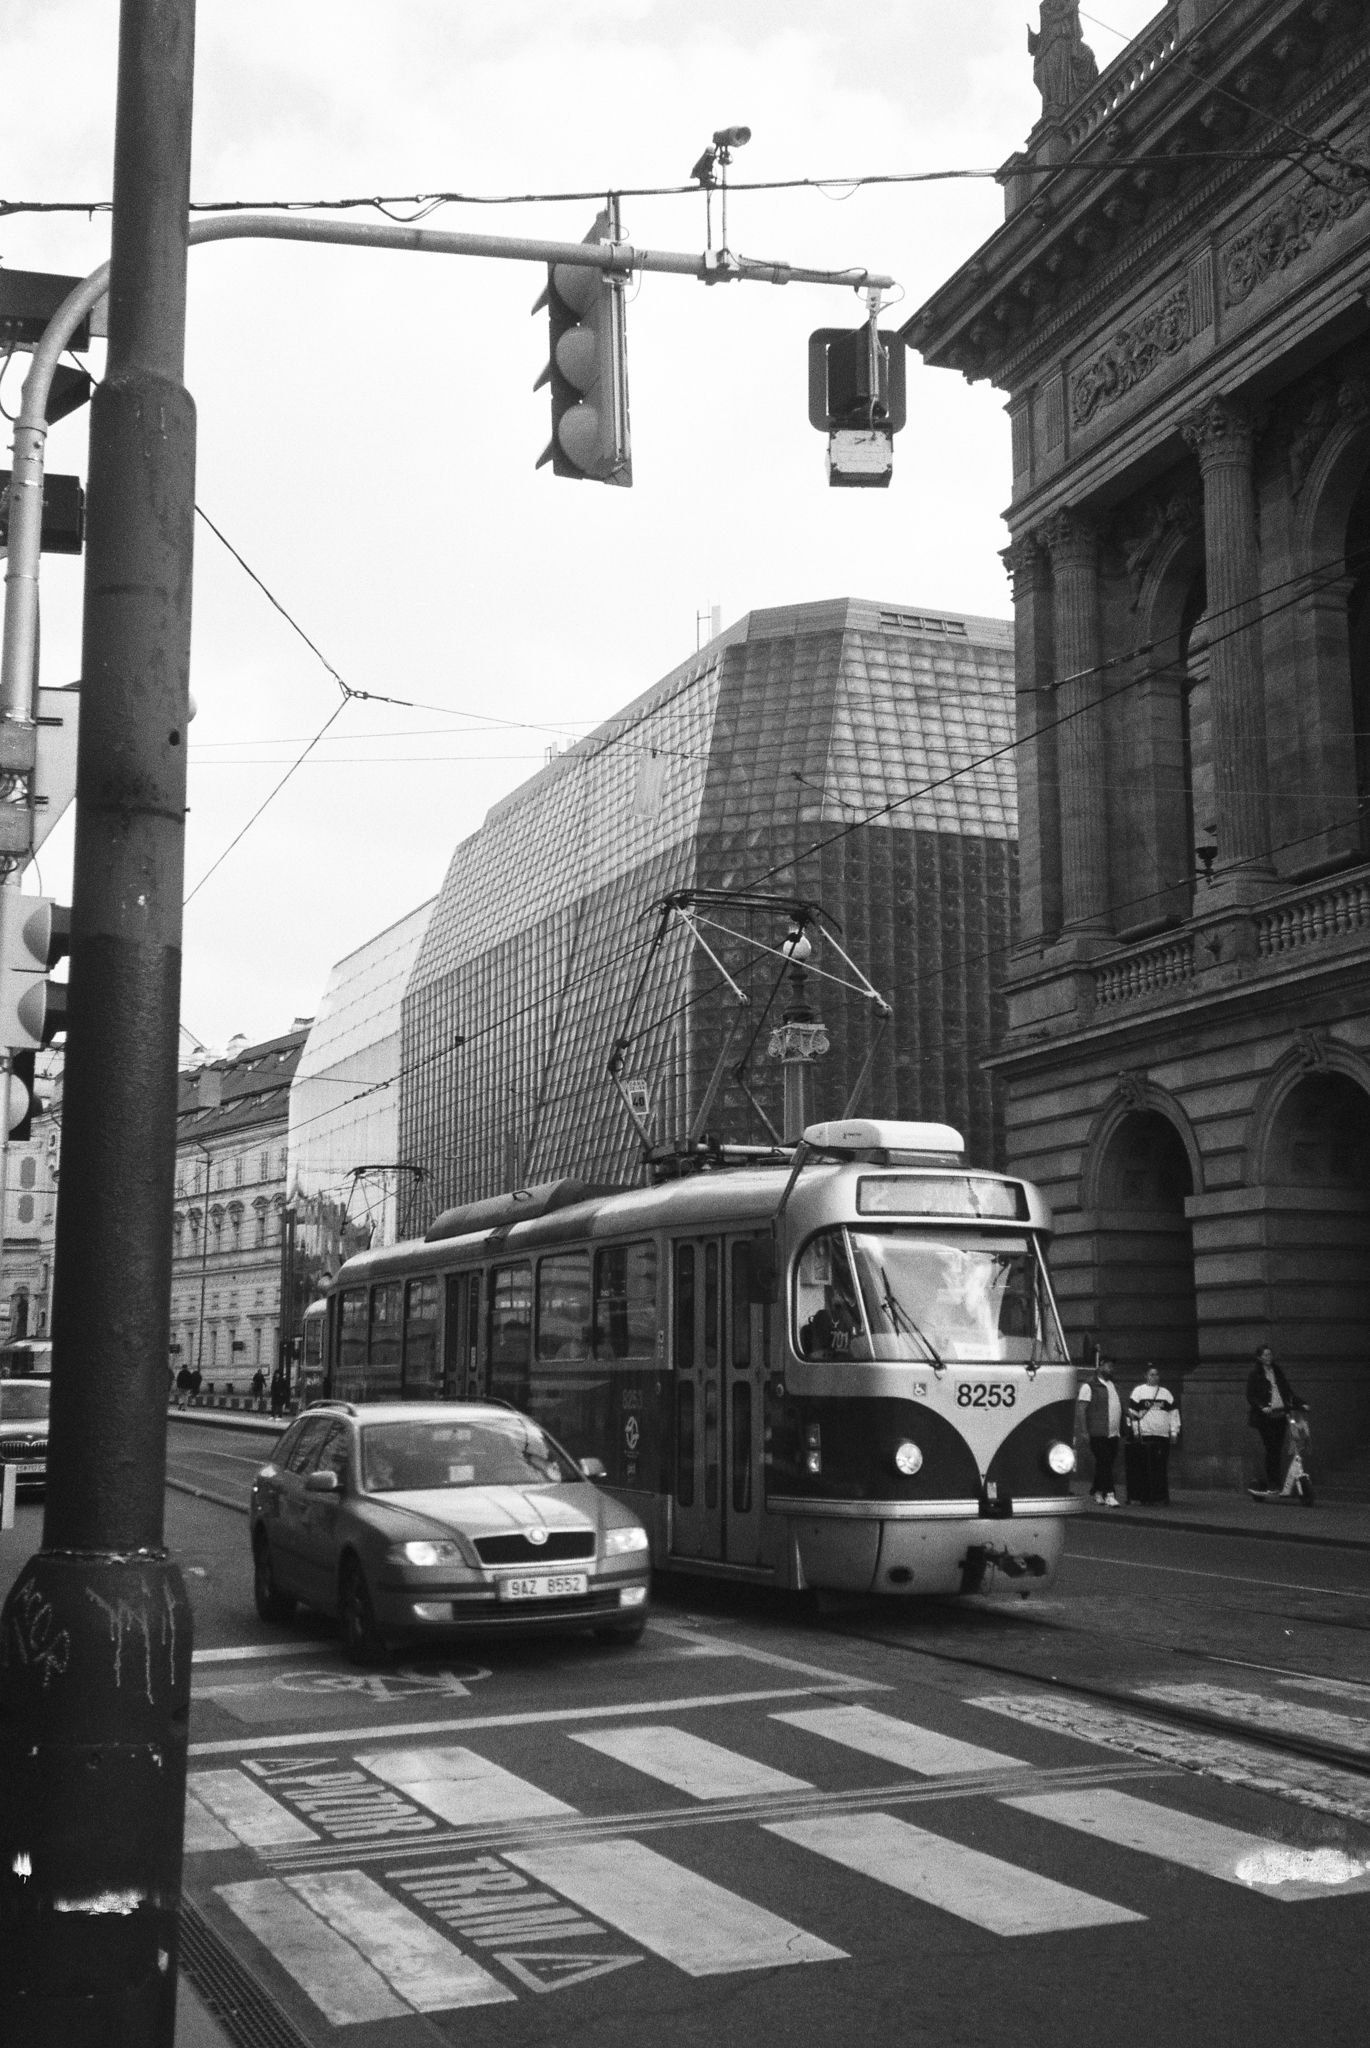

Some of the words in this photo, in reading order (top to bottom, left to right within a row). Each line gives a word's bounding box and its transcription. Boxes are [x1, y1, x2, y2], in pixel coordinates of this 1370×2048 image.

[632, 1097, 646, 1107] 40
[830, 1330, 849, 1348] 701
[957, 1384, 1016, 1407] 8253
[512, 1579, 537, 1595] 9AZ
[547, 1576, 581, 1593] 8552
[264, 1770, 437, 1839] POZOR
[384, 1856, 608, 1947] TRAM
